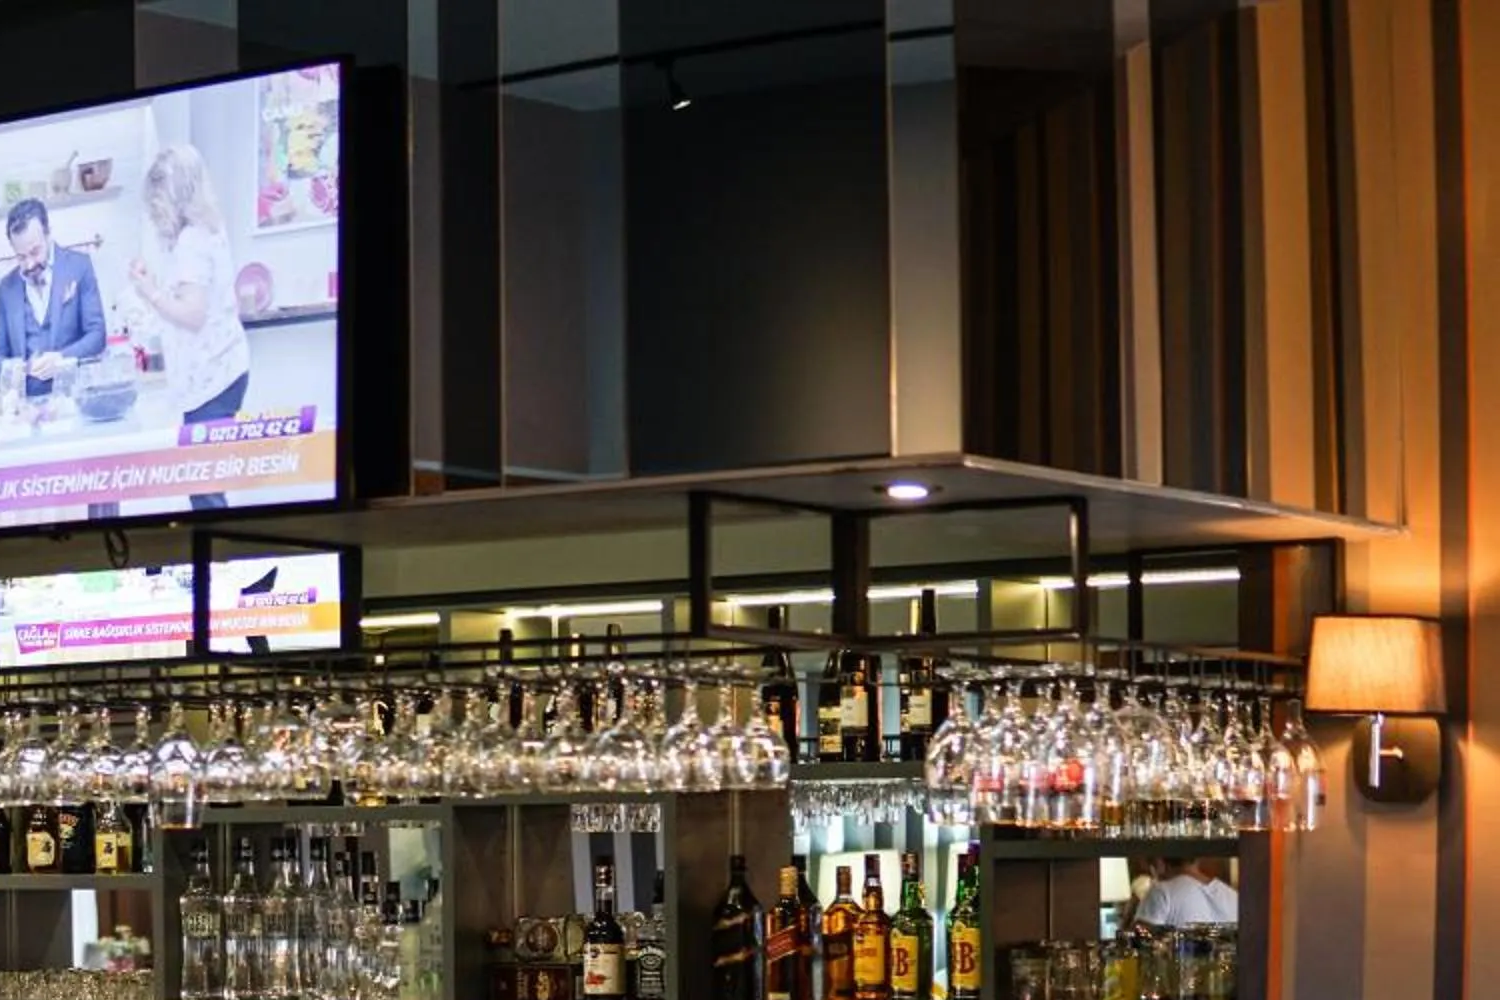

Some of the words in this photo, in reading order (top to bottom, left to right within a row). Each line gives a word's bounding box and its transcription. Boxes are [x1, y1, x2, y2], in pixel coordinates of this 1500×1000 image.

[209, 425, 237, 442] 0212
[240, 423, 264, 438] 702
[266, 421, 282, 435] 42
[284, 419, 300, 434] 42
[21, 468, 110, 497] SİSTEMİMİZ
[111, 465, 146, 491] İÇİN
[149, 461, 213, 485] MUCİZE
[214, 453, 245, 479] BİR
[247, 449, 300, 477] BESİN
